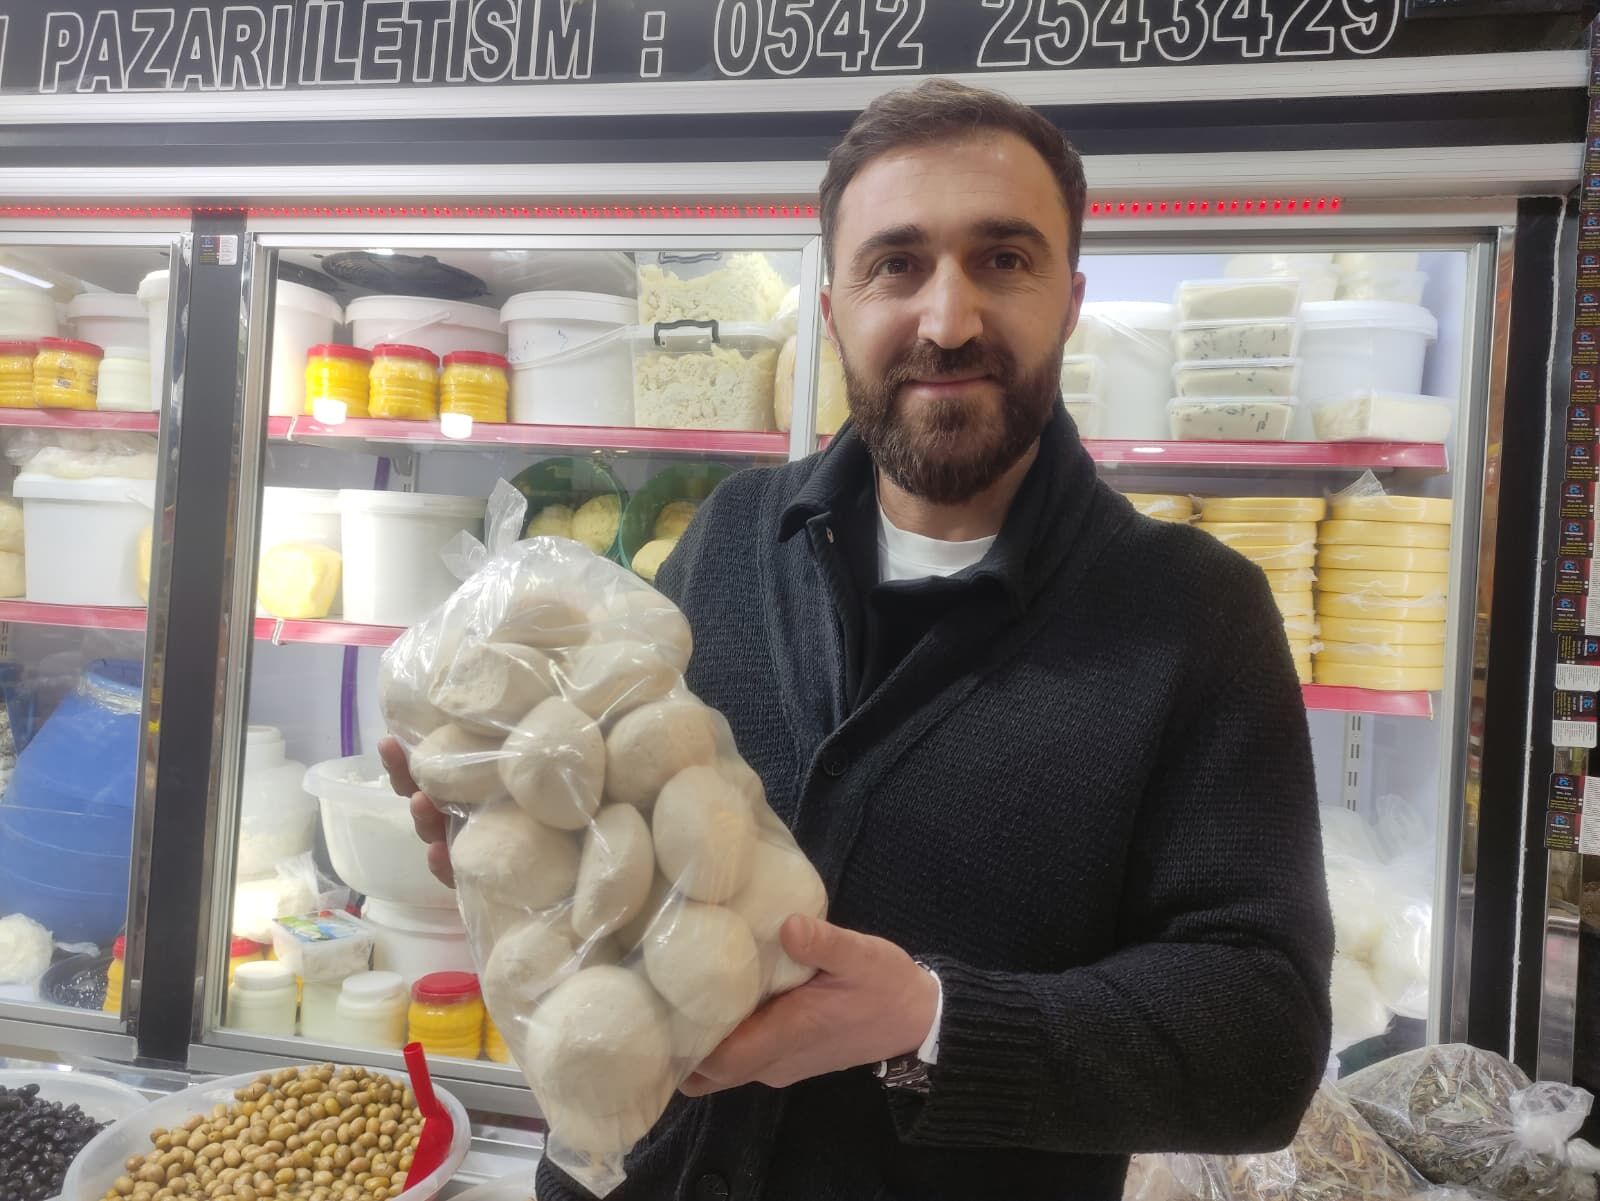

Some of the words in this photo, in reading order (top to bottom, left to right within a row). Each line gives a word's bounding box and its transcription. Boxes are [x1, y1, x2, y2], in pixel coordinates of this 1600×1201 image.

[39, 5, 293, 93] PAZARI
[713, 0, 926, 77] 0542
[976, 0, 1400, 67] 2543429
